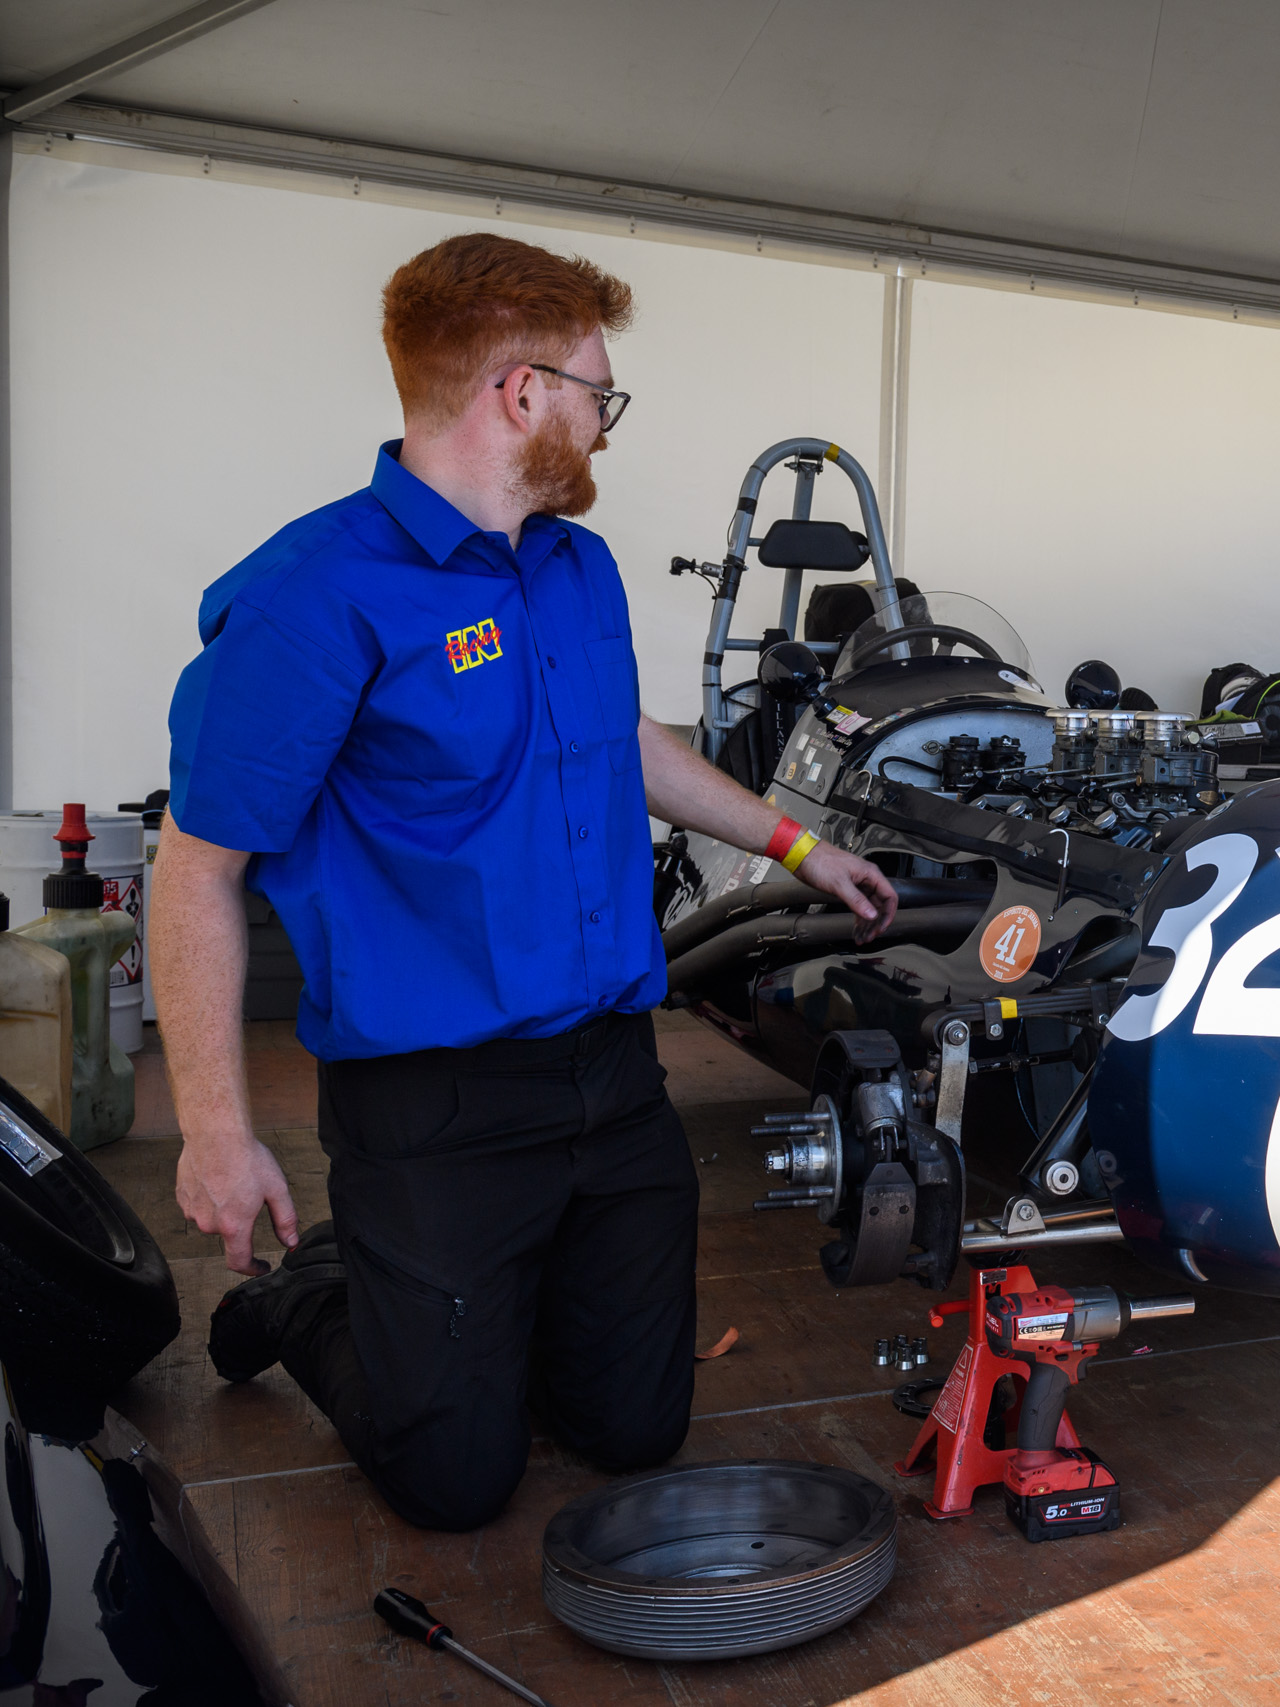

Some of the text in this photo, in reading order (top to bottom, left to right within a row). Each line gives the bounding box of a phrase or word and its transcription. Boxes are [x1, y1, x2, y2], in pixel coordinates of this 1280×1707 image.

[445, 626, 502, 665] Racing
[994, 924, 1026, 966] 41
[1045, 1505, 1067, 1519] 5.0
[1082, 1505, 1101, 1514] M18
